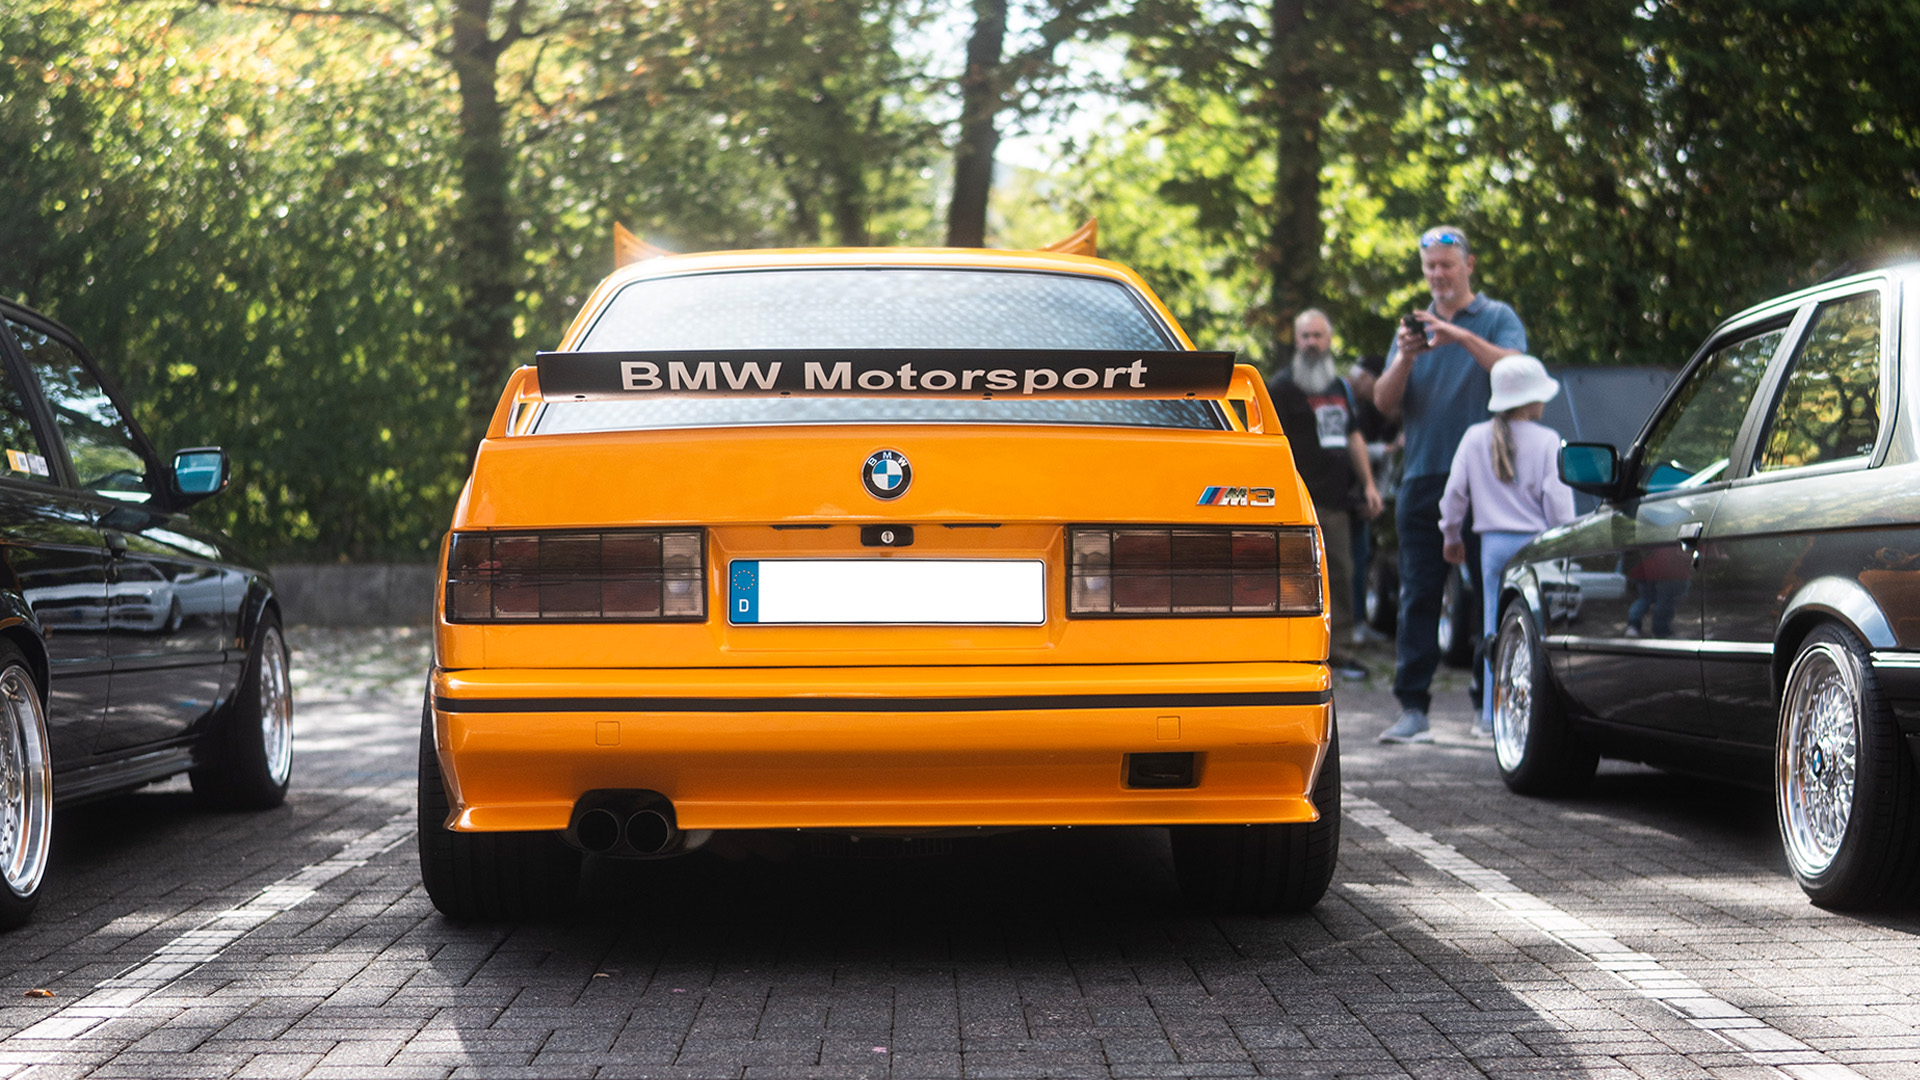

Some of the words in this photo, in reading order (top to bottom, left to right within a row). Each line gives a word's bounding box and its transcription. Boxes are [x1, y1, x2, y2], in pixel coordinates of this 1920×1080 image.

[620, 361, 782, 391] BMW
[804, 359, 1148, 395] Motorsport
[868, 451, 908, 467] BMW
[1218, 486, 1275, 506] M3
[739, 598, 749, 612] D
